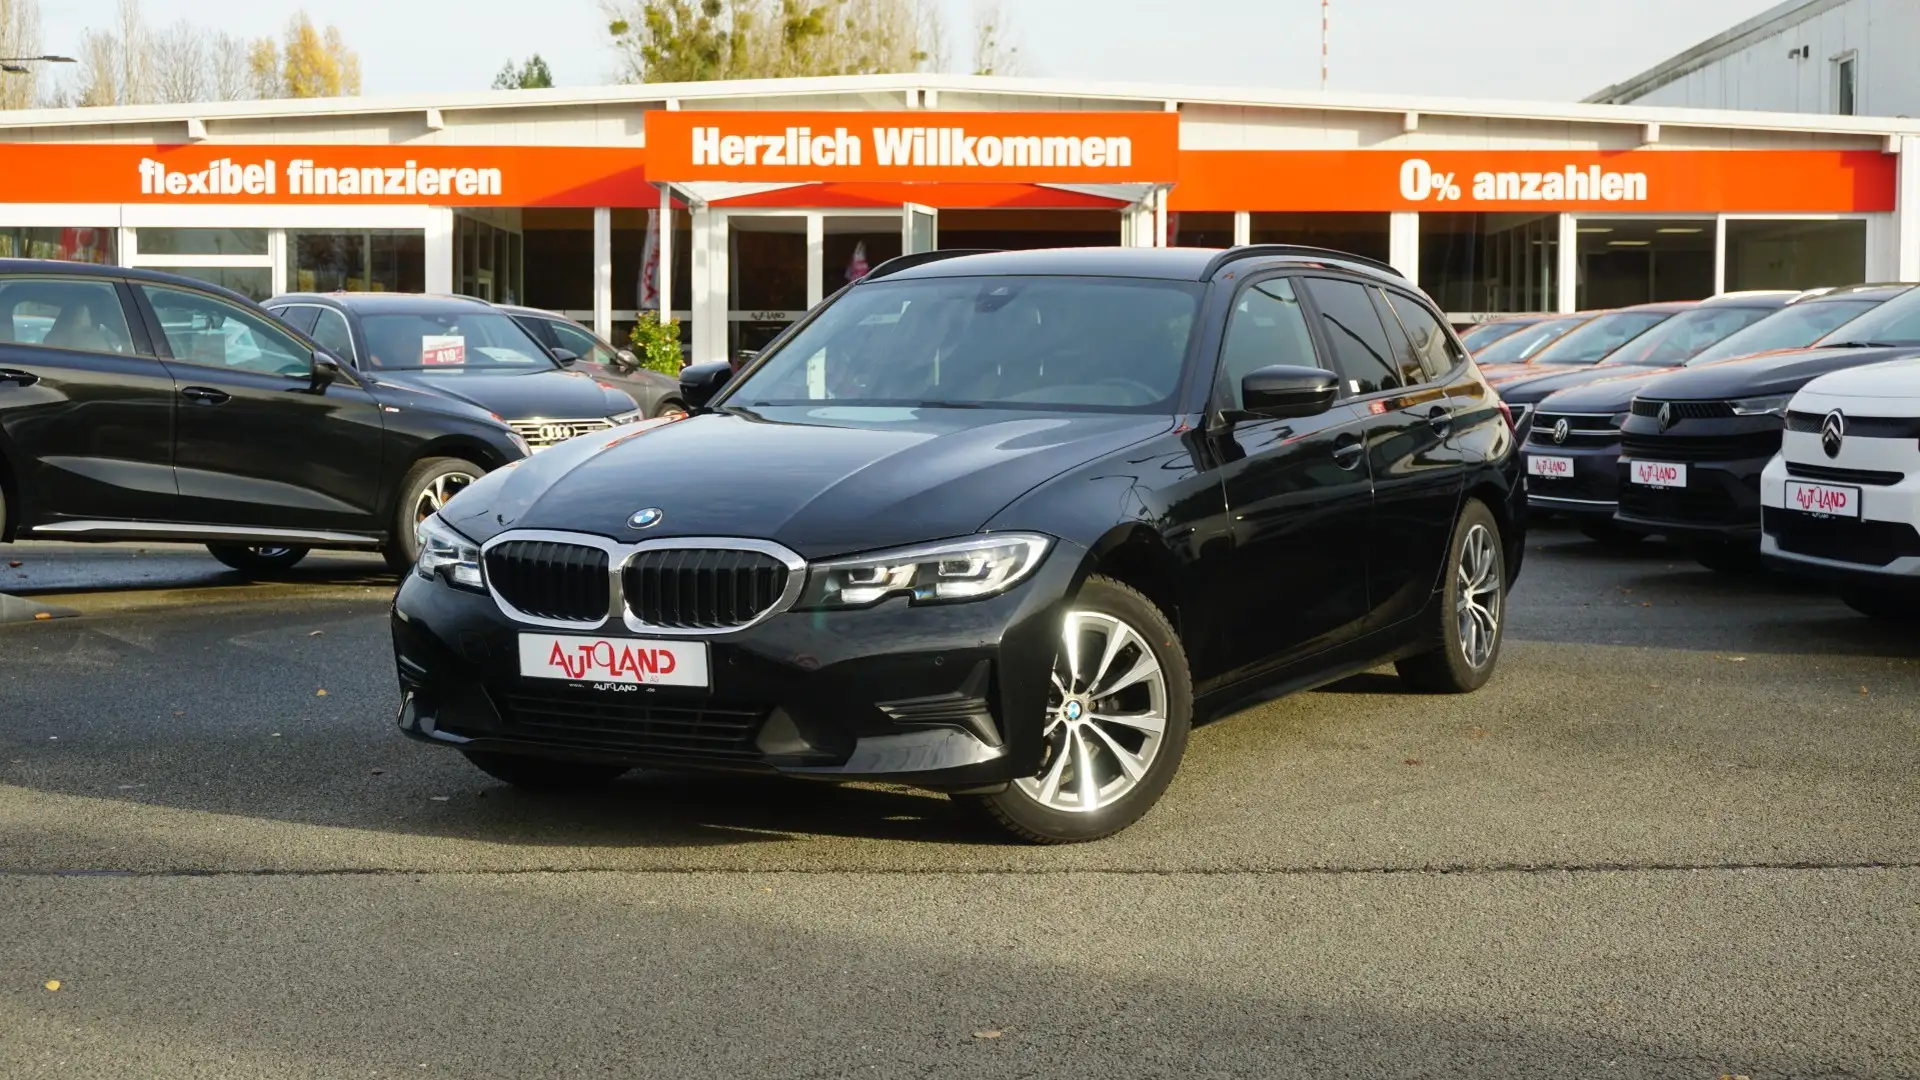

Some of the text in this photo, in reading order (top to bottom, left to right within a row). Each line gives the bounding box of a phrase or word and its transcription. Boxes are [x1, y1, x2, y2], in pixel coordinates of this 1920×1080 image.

[691, 126, 1132, 168] Herzlich Willkommen
[138, 157, 502, 196] flexibel finanzieren
[1399, 158, 1647, 202] 0% anzahlen
[1535, 457, 1567, 476] AUTOLAND
[1639, 463, 1677, 484] AUTOLAND
[1796, 485, 1847, 513] AUTOLAND
[548, 640, 676, 682] AUTOLAND
[593, 682, 638, 693] AUTOLAND
